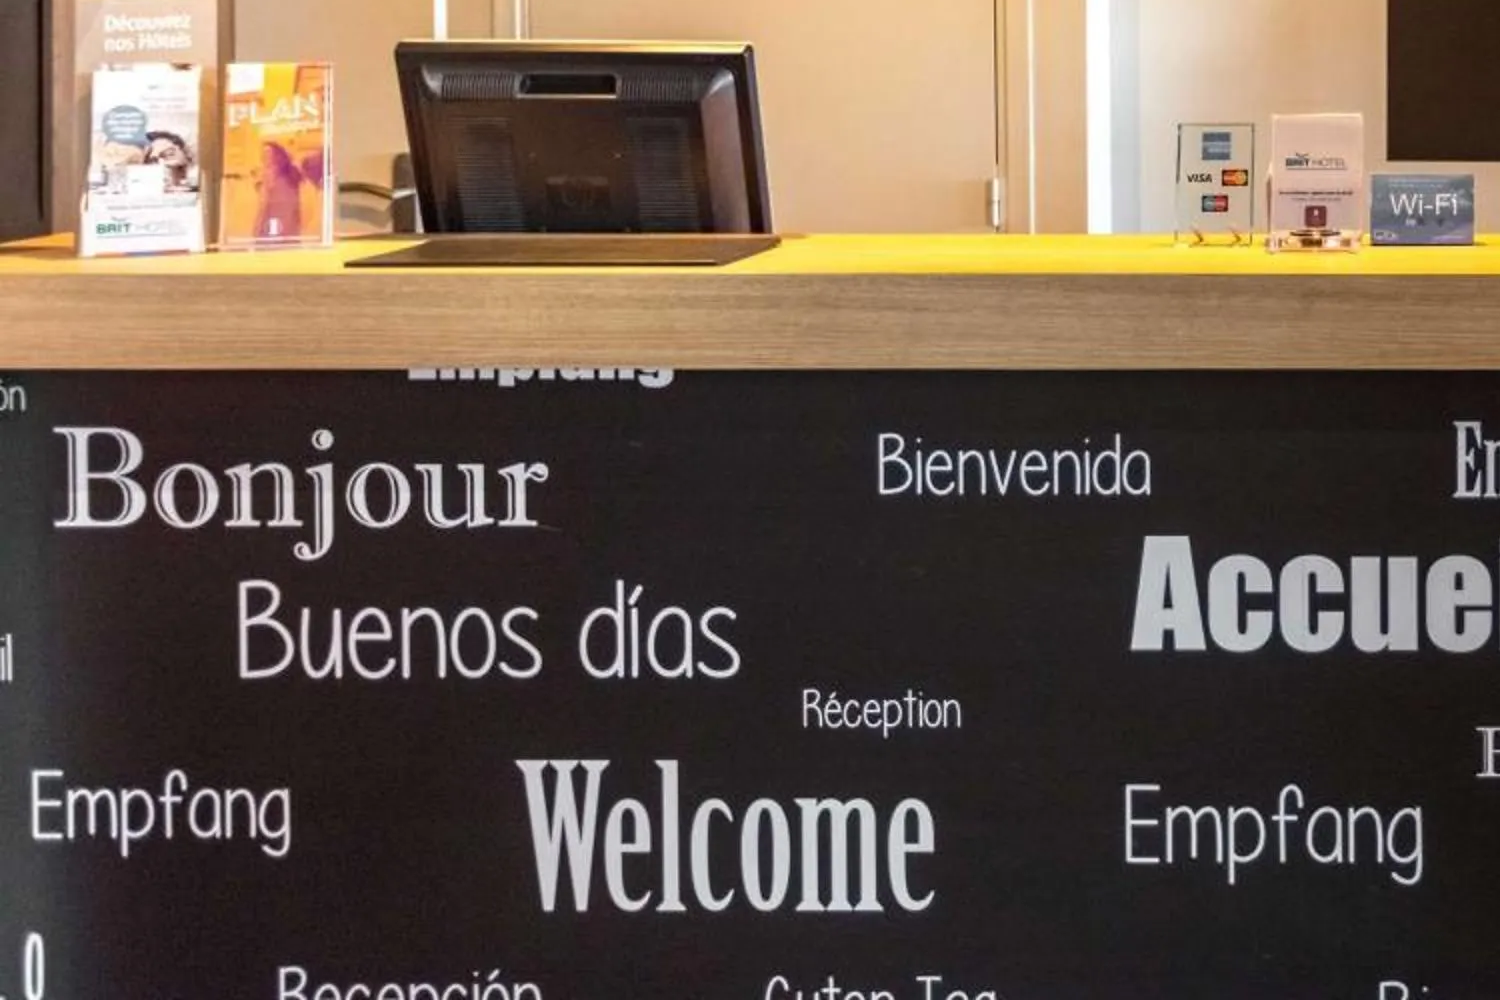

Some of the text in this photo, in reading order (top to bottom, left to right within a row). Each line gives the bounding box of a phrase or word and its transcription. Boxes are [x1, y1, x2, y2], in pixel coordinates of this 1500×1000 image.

[105, 36, 135, 52] nos
[1187, 173, 1213, 183] VISA
[1389, 193, 1457, 216] Wi-Fi
[53, 427, 548, 560] Bonjour
[878, 433, 1150, 496] Bienvenida
[239, 580, 740, 679] Buenos días
[803, 689, 961, 738] Réception
[31, 769, 290, 857] Empfang
[516, 760, 934, 912] Welcome
[1126, 784, 1422, 884] Empfang
